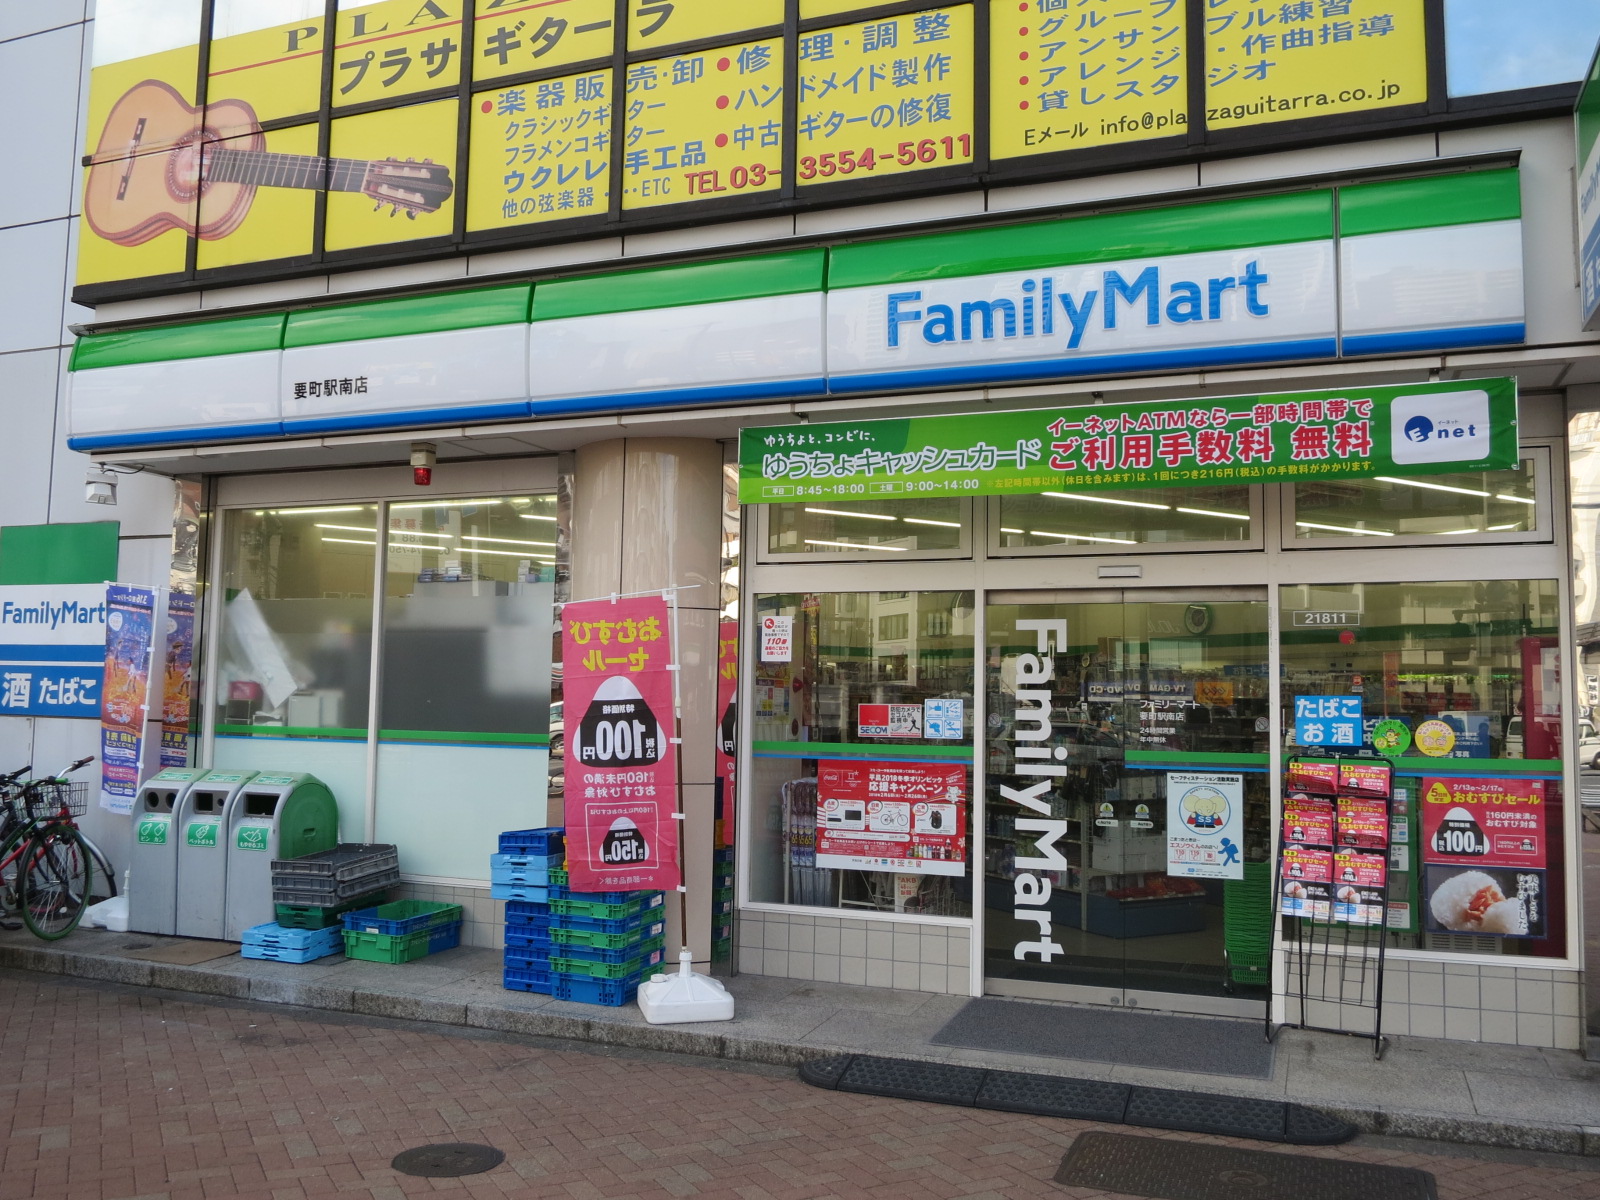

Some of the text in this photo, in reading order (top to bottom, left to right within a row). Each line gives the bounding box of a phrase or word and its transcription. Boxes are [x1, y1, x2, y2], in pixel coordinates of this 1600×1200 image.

[886, 259, 1270, 350] FamilyMart
[294, 376, 368, 400] 要町駅南店
[1047, 398, 1374, 438] イーネットATMなら一部時間帯で
[762, 438, 1042, 481] ゆうちょキャッシュカード
[2, 601, 106, 631] FamilyMart
[1304, 613, 1347, 624] 21811
[2, 672, 97, 709] 酒 たばこ
[1139, 700, 1200, 710] ファミリーマート
[1296, 698, 1361, 719] たばこ
[1139, 711, 1185, 721] 要町駅南店
[860, 726, 888, 734] SECOM
[1139, 727, 1176, 735] 24時間営業
[1139, 736, 1167, 744] 年中無休
[868, 781, 944, 794] 応援キャンペーン
[1000, 618, 1068, 963] FamilyMart
[1453, 791, 1541, 805] おむすびセール
